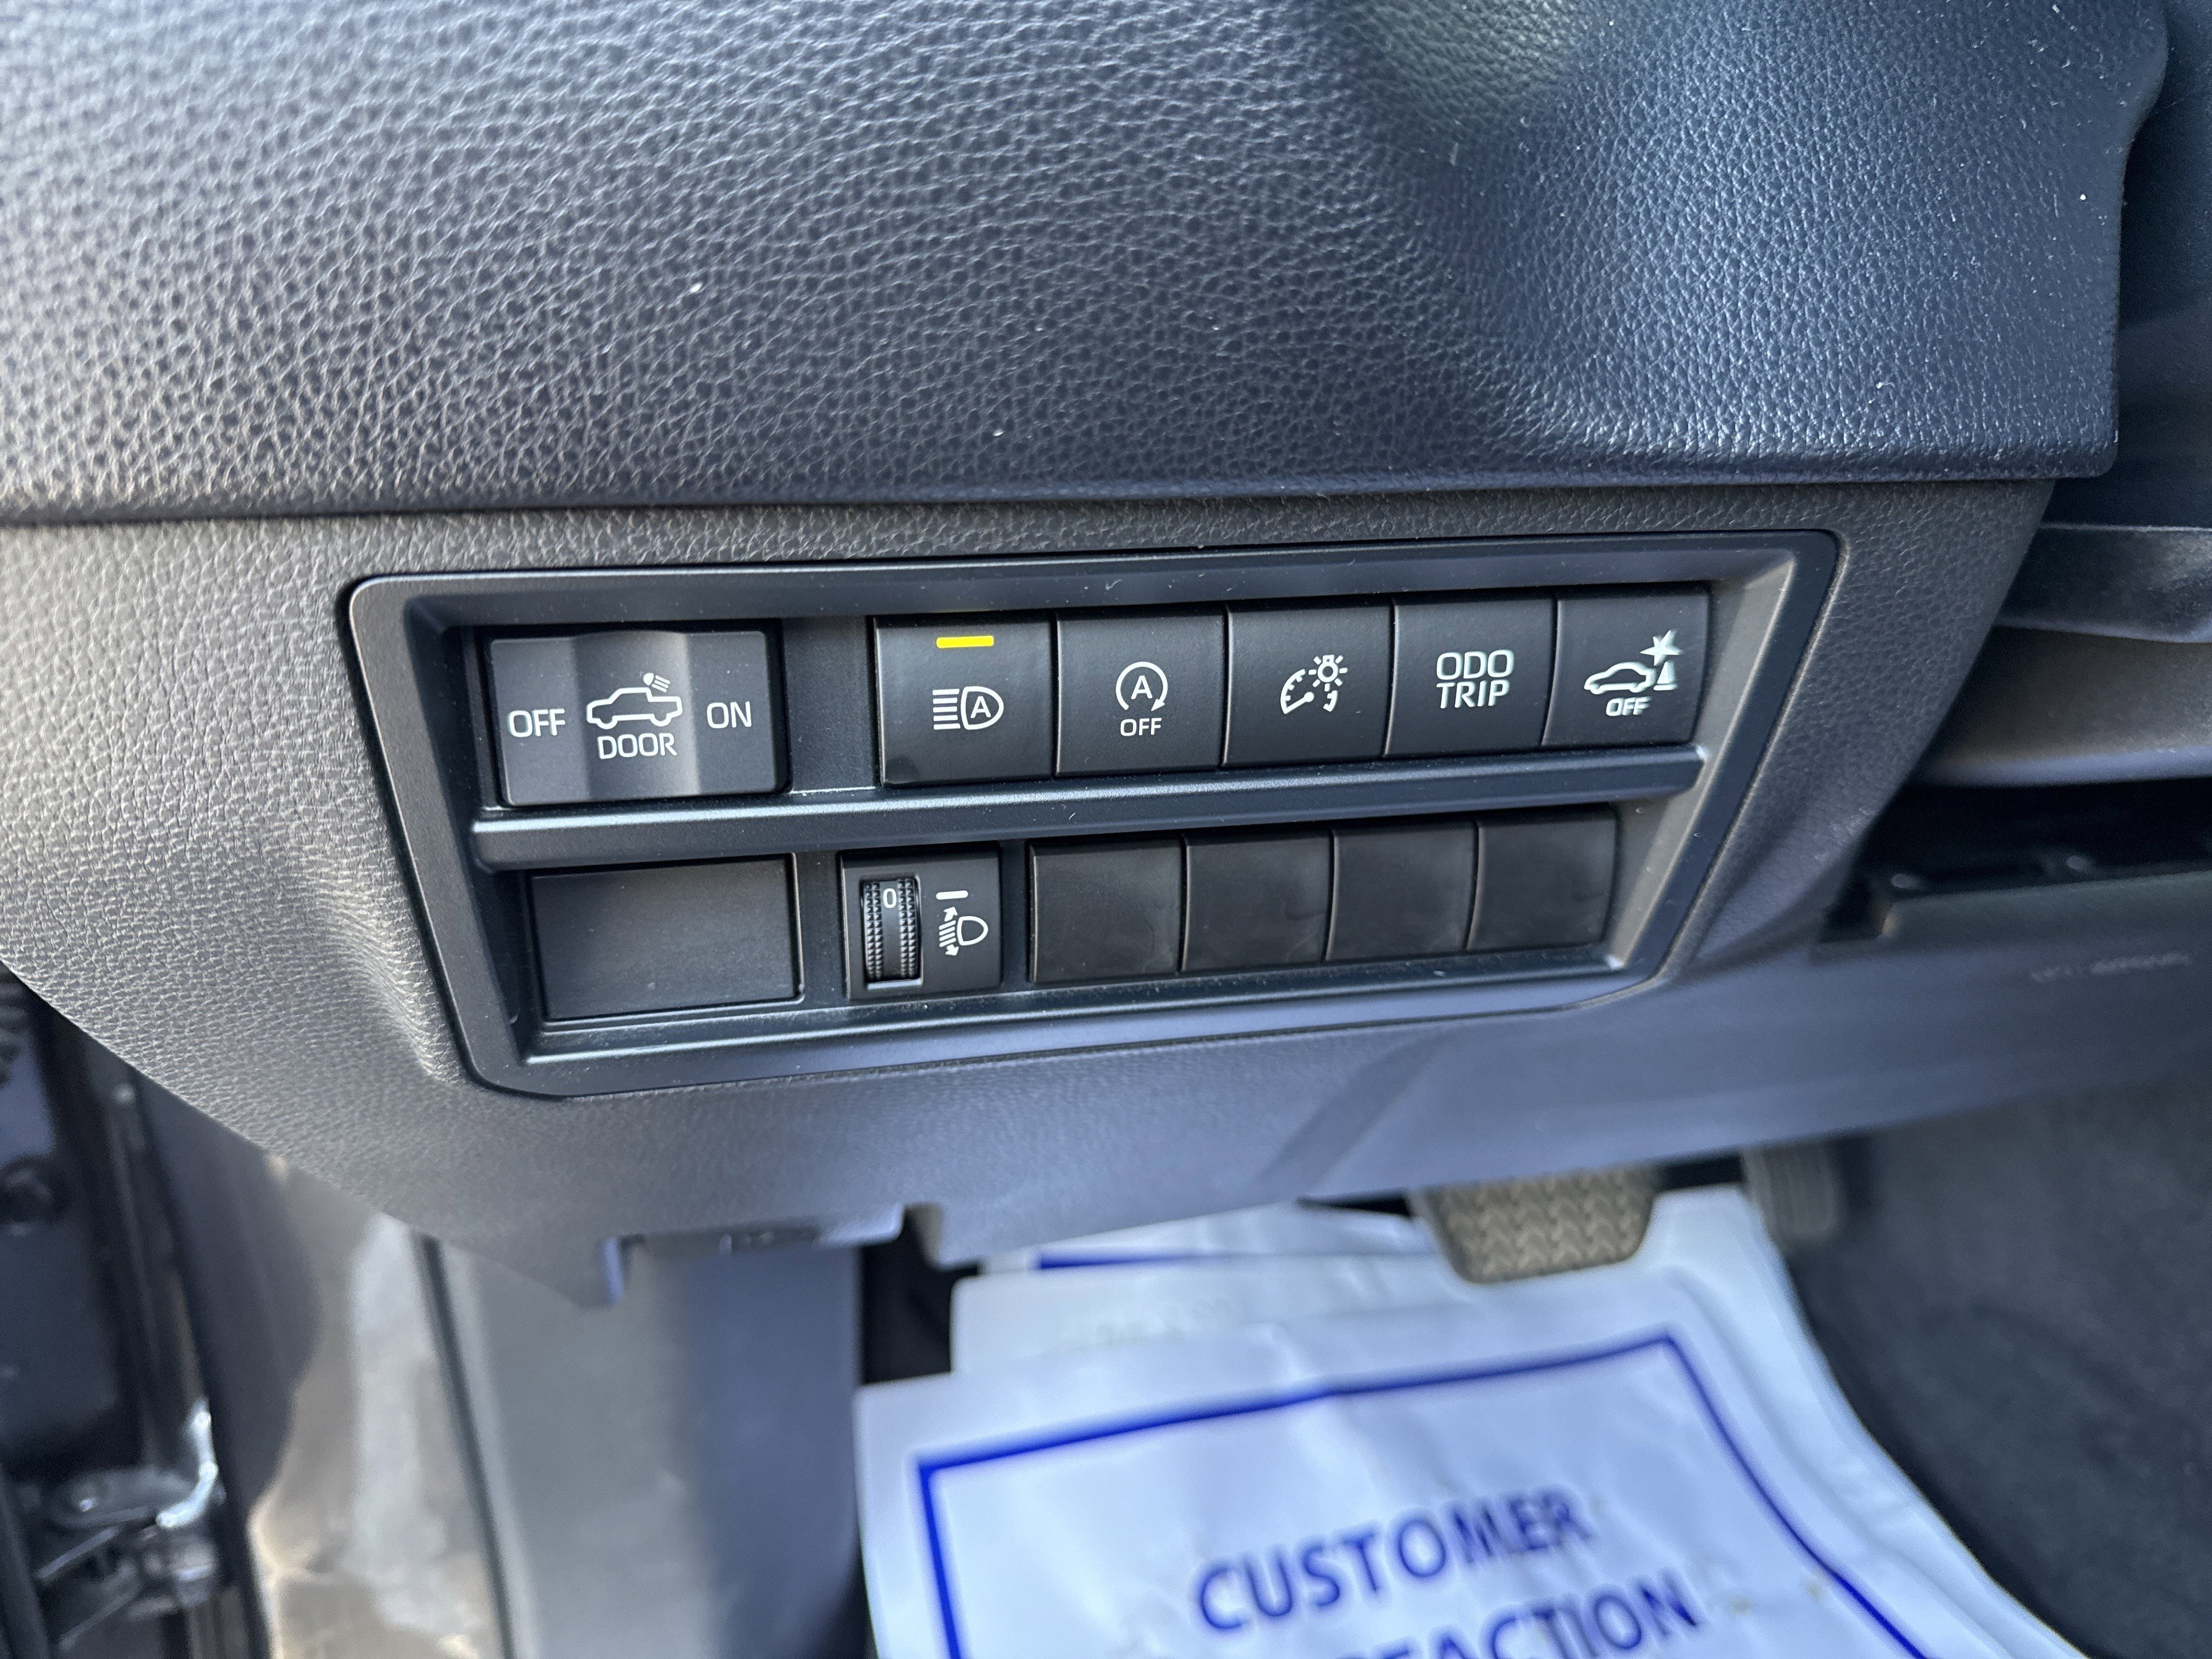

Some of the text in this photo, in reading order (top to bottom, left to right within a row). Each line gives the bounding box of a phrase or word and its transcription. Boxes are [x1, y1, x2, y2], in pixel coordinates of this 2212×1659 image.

[1436, 649, 1515, 680] ODO
[1130, 675, 1153, 700] A
[1435, 679, 1511, 709] TRIP
[706, 701, 752, 729] ON
[969, 695, 992, 719] A
[1605, 696, 1652, 717] OFF
[507, 707, 566, 738] OFF
[1120, 716, 1163, 737] OFF
[597, 732, 678, 760] DOOR
[1198, 1488, 1594, 1634] CUSTOMER
